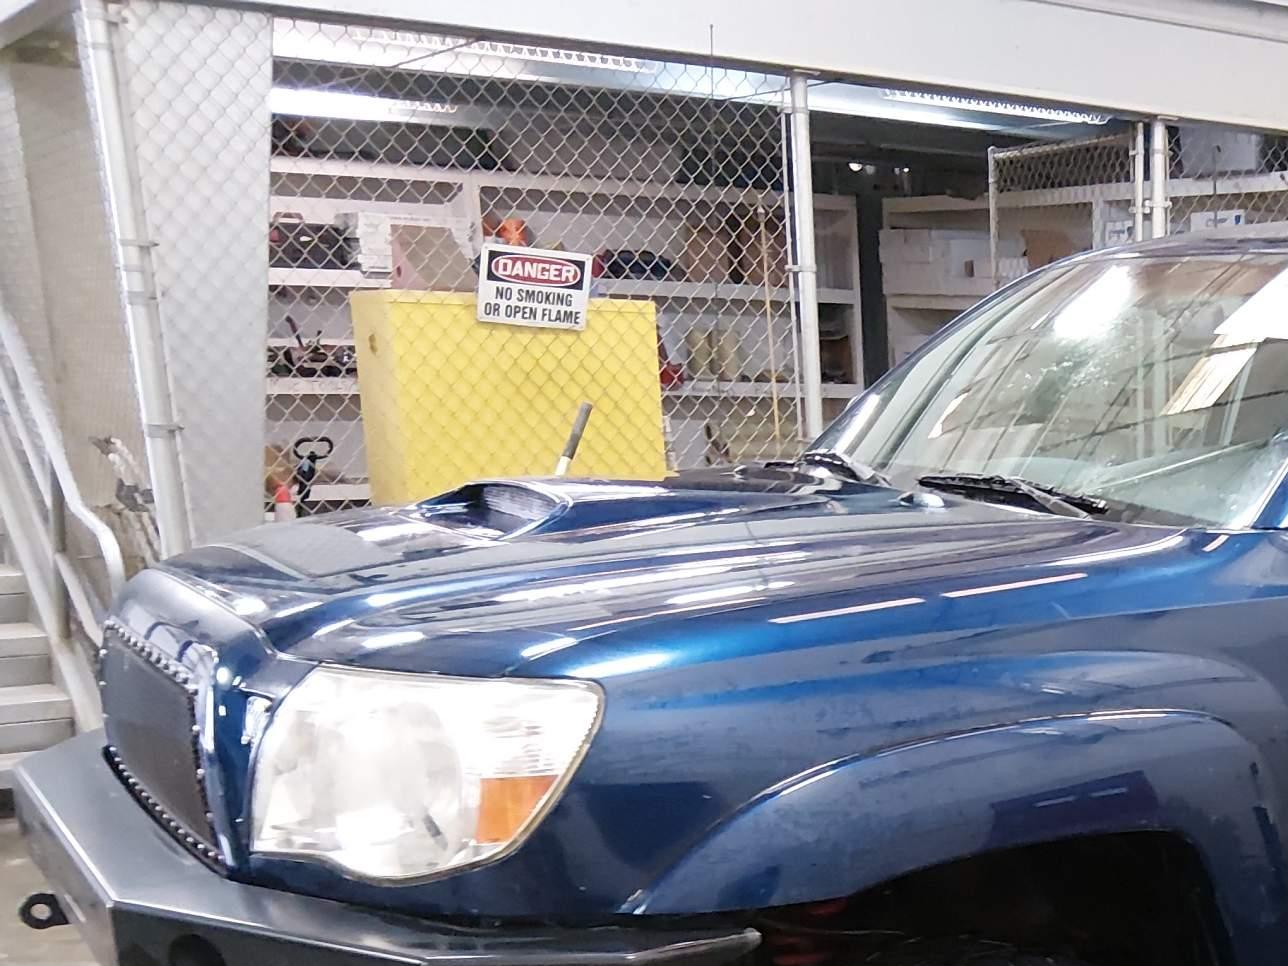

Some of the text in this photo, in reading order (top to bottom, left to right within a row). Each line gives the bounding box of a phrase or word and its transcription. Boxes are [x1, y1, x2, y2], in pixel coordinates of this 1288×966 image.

[499, 259, 575, 283] DANGER
[495, 286, 573, 307] NO SMOKING
[484, 302, 582, 325] OR OPEN FLAME
